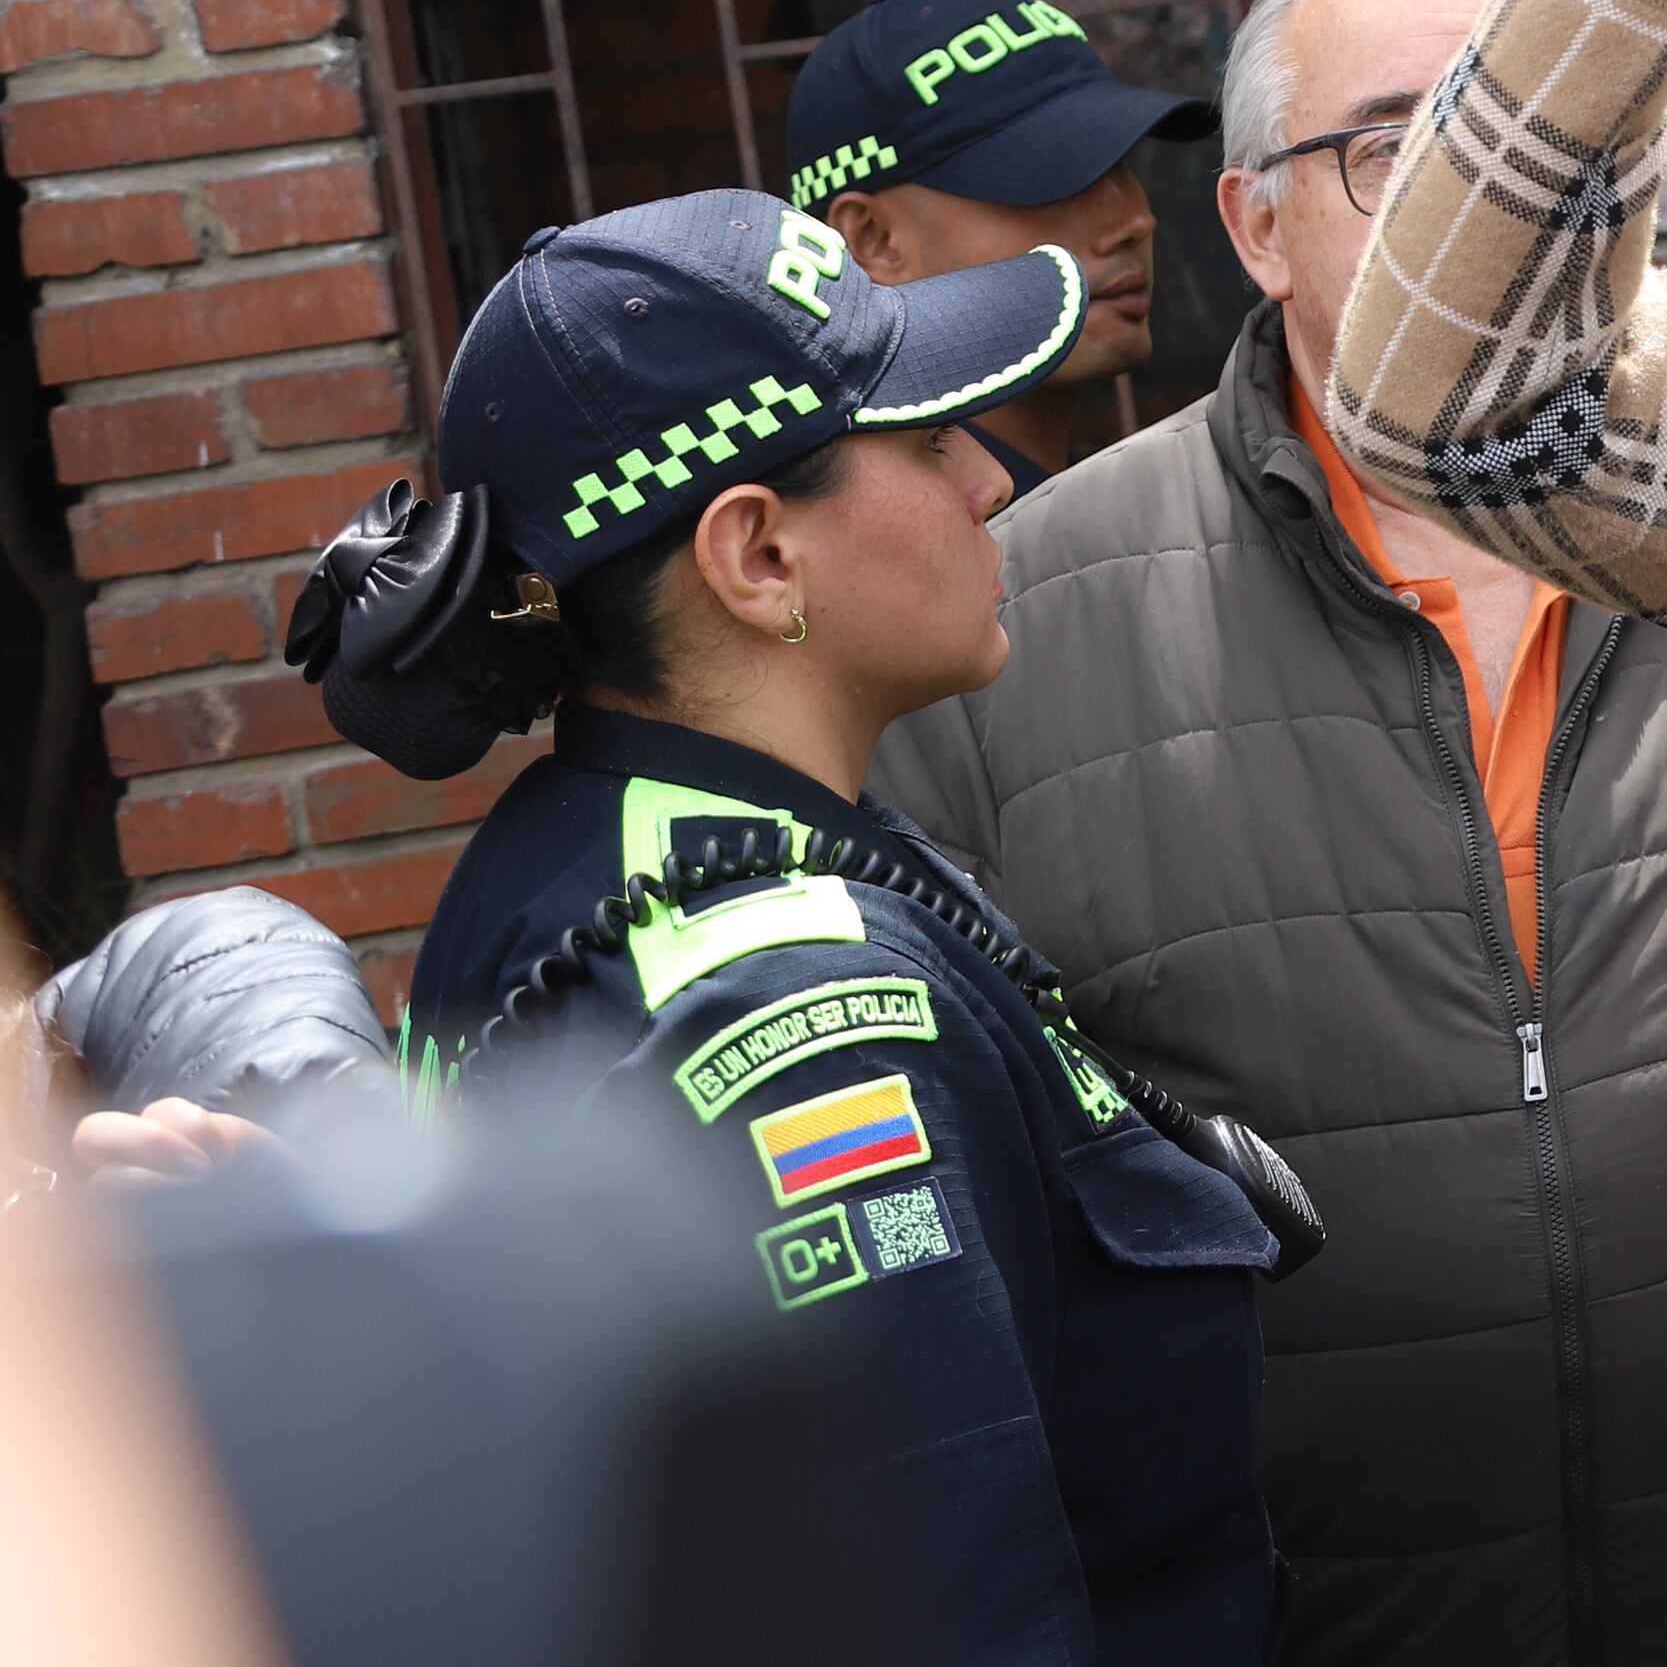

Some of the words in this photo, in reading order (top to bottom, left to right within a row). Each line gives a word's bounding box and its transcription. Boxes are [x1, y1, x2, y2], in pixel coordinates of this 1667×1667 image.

[692, 1067, 726, 1101] ES
[713, 1045, 752, 1082] UN
[740, 1012, 813, 1066] HONOR
[806, 1000, 848, 1034] SER
